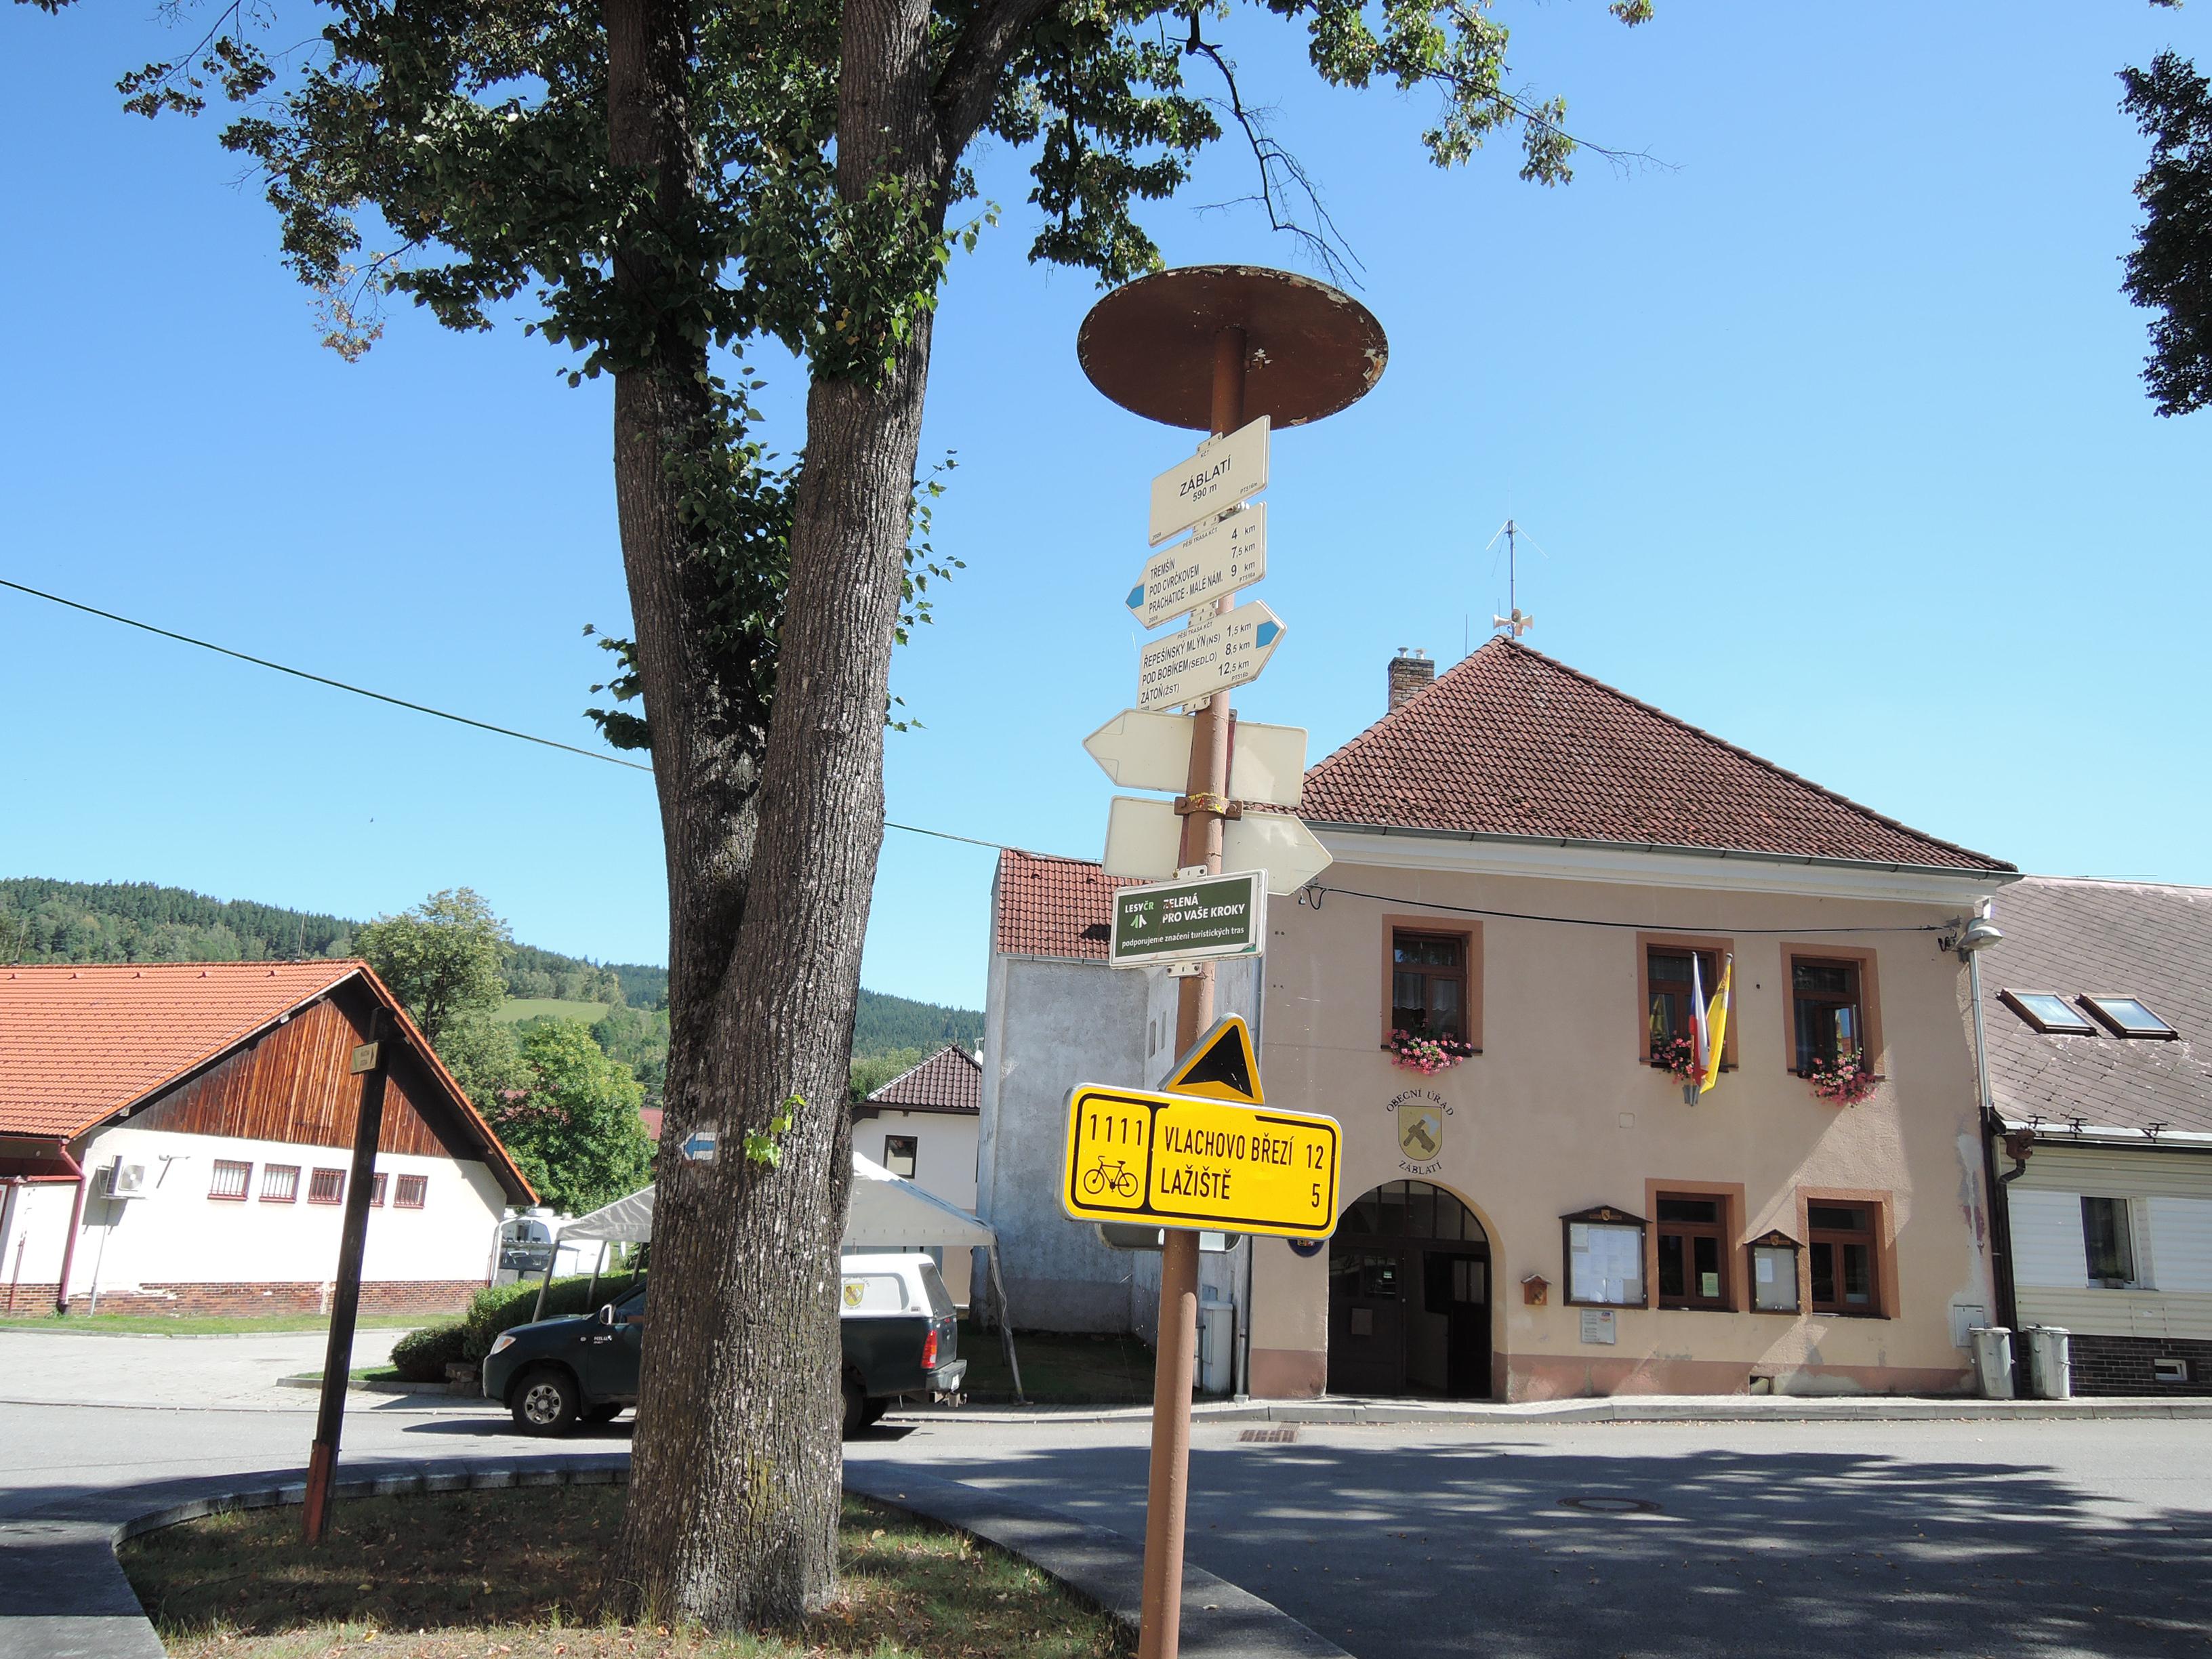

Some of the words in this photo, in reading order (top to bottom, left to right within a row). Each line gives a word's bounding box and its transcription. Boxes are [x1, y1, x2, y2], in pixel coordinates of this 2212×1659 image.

[1200, 449, 1210, 458] KČT
[1179, 454, 1231, 497] ZÁBLATÍ
[1192, 487, 1207, 502] 590
[1209, 483, 1217, 493] m
[1193, 532, 1208, 544] TRASA
[1208, 527, 1218, 536] KČT
[1150, 557, 1175, 581] TŘEMŠÍN
[1231, 528, 1237, 540] 4
[1244, 524, 1256, 535] km
[1149, 583, 1161, 598] POD
[1162, 564, 1200, 591] CVRČKOVEM
[1231, 546, 1243, 559] 7,5
[1244, 543, 1256, 554] km
[1149, 587, 1185, 615] PRACHATICE
[1189, 575, 1206, 596] MALÉ
[1207, 571, 1223, 588] NÁM.
[1231, 565, 1237, 577] 9
[1244, 561, 1255, 572] km
[1177, 630, 1187, 640] PĚŠÍ
[1188, 625, 1203, 635] TRASA
[1204, 621, 1213, 630] KČT
[1143, 640, 1185, 669] ŘEPEŠÍNSKÝ
[1227, 624, 1239, 638] 1,5
[1240, 622, 1252, 633] km
[1142, 672, 1156, 686] POD
[1225, 643, 1237, 656] 8,5
[1239, 641, 1250, 651] km
[1218, 662, 1236, 676] 12,5
[1238, 659, 1250, 670] km
[1162, 913, 1182, 924] PRO
[1185, 907, 1208, 921] VAŠE
[1211, 903, 1246, 918] KROKY
[1163, 893, 1199, 909] ZELENÁ
[1122, 936, 1164, 949] podporujeme
[1165, 930, 1189, 942] značení
[1191, 927, 1230, 939] turistických
[1387, 1088, 1422, 1112] OBECNÍ
[1427, 1090, 1454, 1116] ÚŘAD
[1090, 1113, 1143, 1146] 1111
[1165, 1125, 1246, 1161] VLACHOVO
[1251, 1132, 1295, 1166] BŘEZÍ
[1307, 1144, 1324, 1170] 12
[1399, 1160, 1442, 1174] ZÁBLATÍ
[1161, 1164, 1231, 1200] LAŽIŠTĚ
[1311, 1184, 1321, 1208] 5
